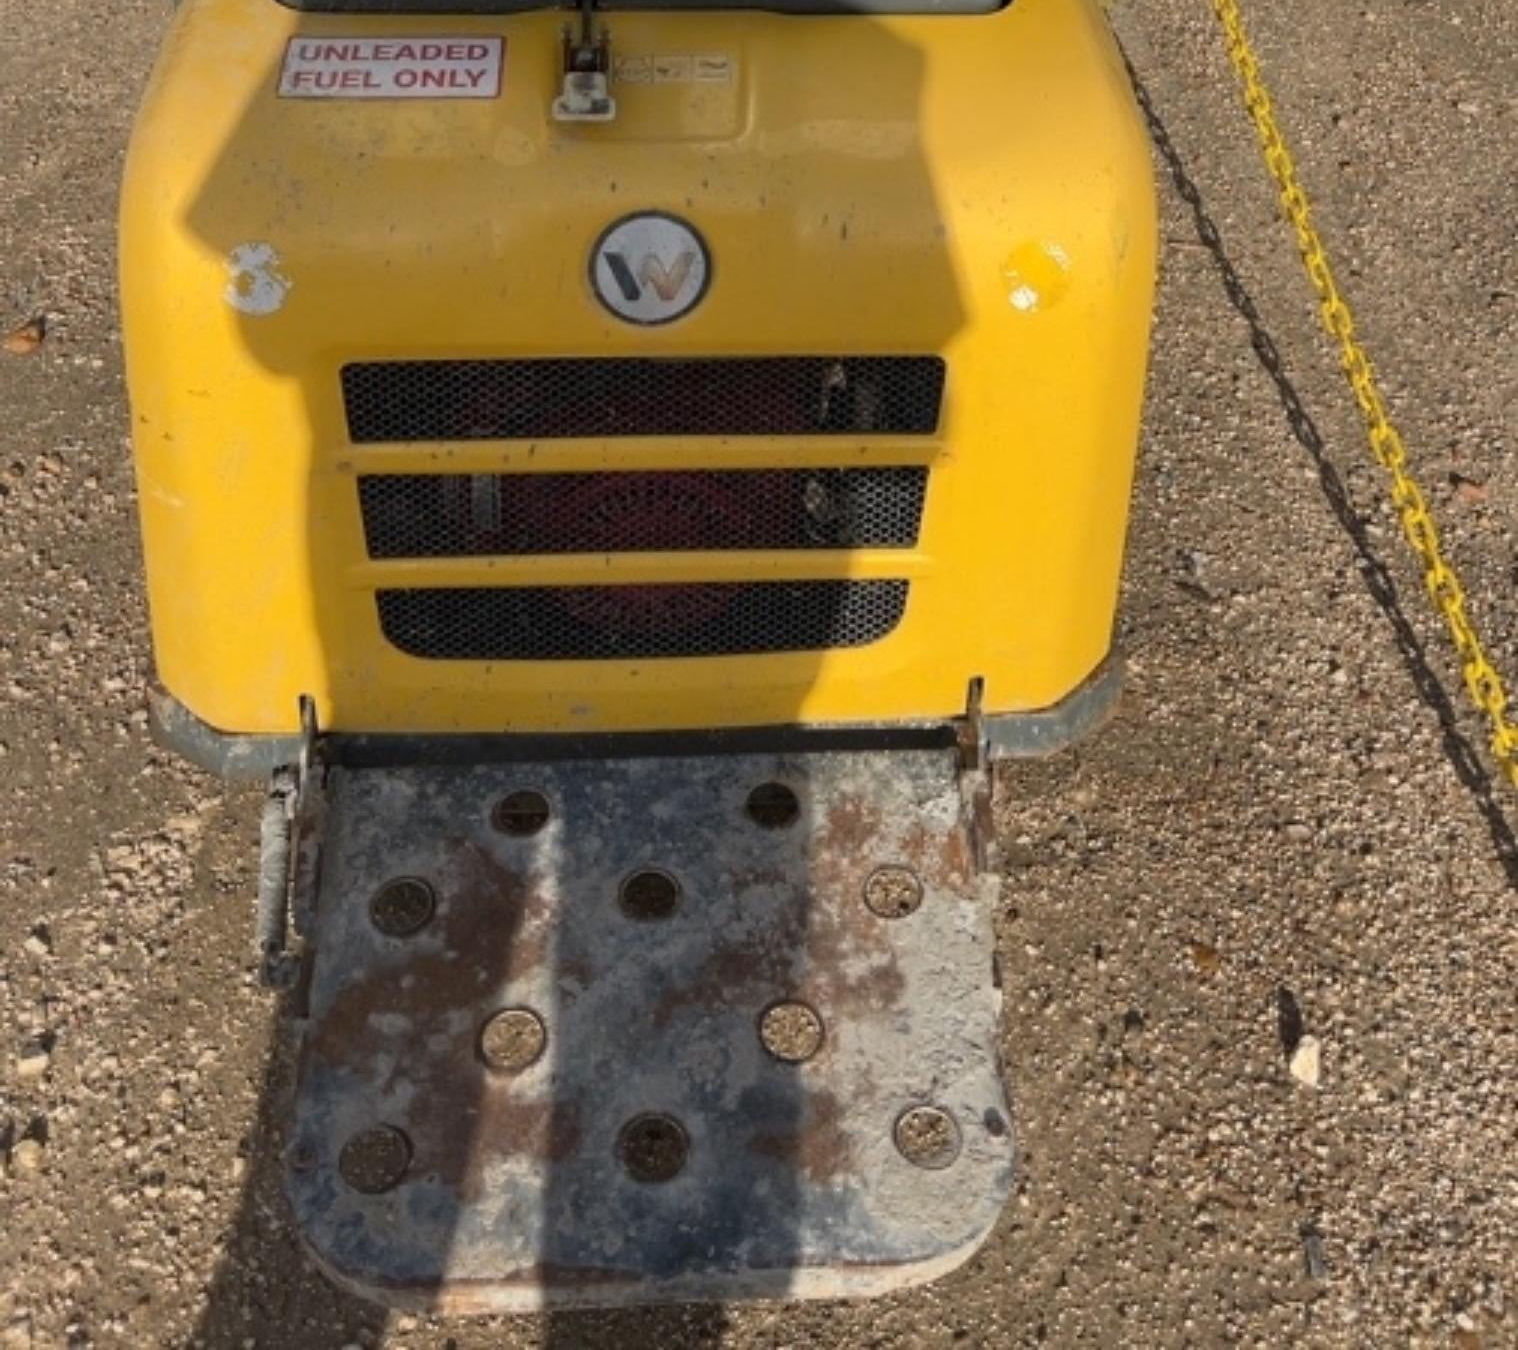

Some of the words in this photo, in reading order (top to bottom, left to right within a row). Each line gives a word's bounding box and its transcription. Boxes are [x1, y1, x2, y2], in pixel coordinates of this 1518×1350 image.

[299, 43, 490, 62] UNLEADED
[291, 69, 382, 89] FUEL
[392, 68, 489, 89] ONLY
